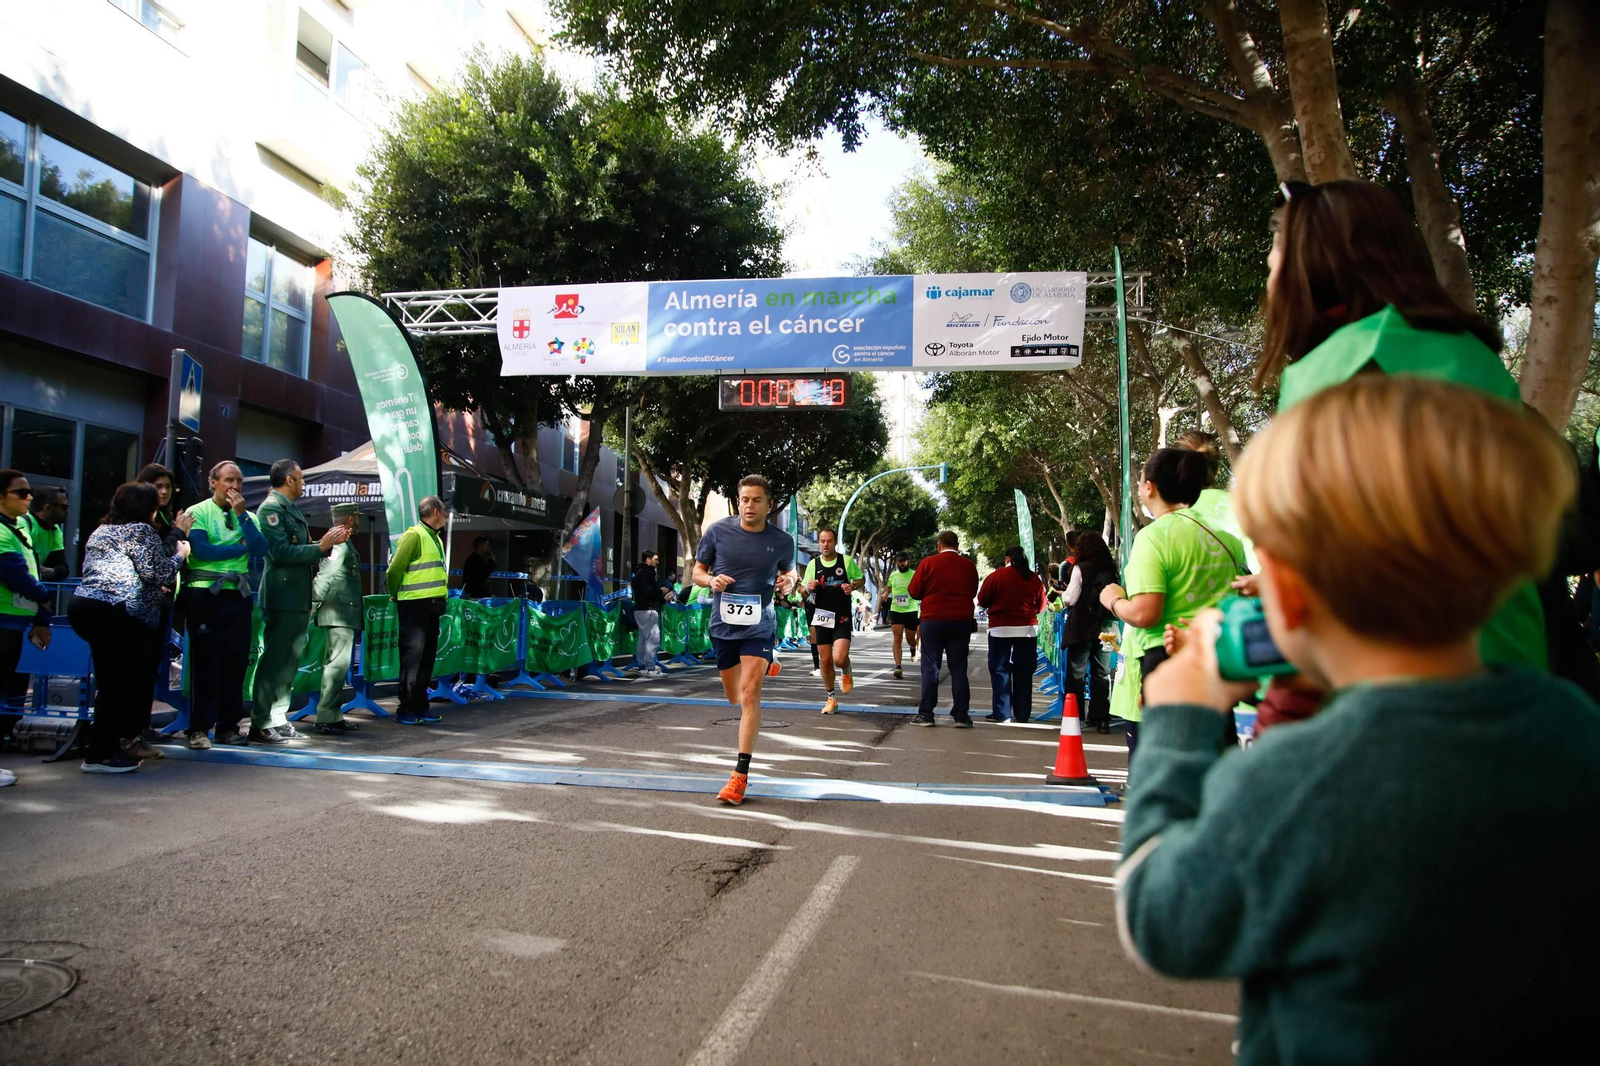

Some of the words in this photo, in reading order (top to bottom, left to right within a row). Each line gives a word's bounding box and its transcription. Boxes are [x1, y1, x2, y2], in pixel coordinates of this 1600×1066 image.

[664, 288, 757, 310] Almería
[765, 291, 795, 307] en
[803, 285, 897, 306] marcha
[945, 286, 995, 300] cajamar
[664, 317, 741, 337] contra
[749, 315, 771, 335] el
[779, 314, 865, 334] cáncer
[993, 315, 1050, 327] Fundación
[1021, 333, 1042, 343] Ejido
[1043, 333, 1069, 341] Motor
[503, 341, 537, 351] ALMERÍA
[656, 354, 735, 364] #TodosContraElCáncer
[949, 349, 978, 357] Alborán
[496, 489, 547, 511] cruzandolameta
[727, 603, 753, 616] 373
[816, 614, 831, 622] 507
